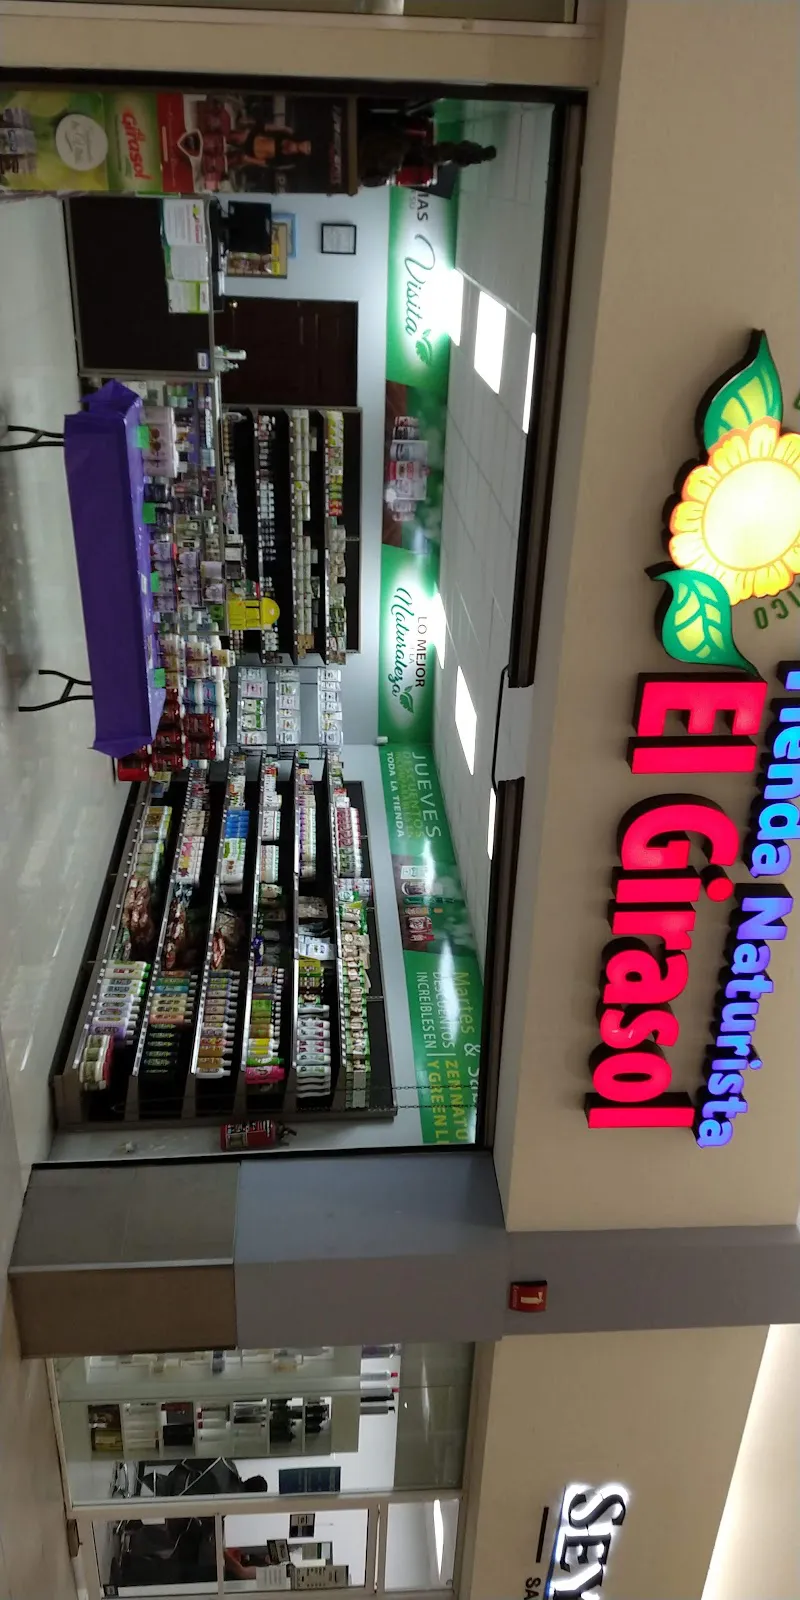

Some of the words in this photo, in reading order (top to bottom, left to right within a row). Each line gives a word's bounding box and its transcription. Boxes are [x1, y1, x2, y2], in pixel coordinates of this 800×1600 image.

[404, 234, 436, 337] Visita
[388, 587, 415, 698] Naturaleza
[417, 616, 427, 635] LO
[415, 640, 427, 688] MEJOR
[631, 681, 768, 774] El
[387, 752, 396, 776] TODA
[390, 781, 398, 791] LA
[750, 671, 800, 877] enda
[392, 795, 405, 838] TIENDA
[412, 752, 441, 838] JUEVES
[588, 803, 739, 1129] Girasol
[417, 972, 434, 1031] INCREÍBLES
[433, 972, 456, 1048] DESCUENTOS
[453, 972, 475, 1034] Martes
[464, 1043, 481, 1056] &
[697, 898, 793, 1148] Naturista
[424, 1033, 436, 1048] EN
[427, 1061, 439, 1069] Y
[429, 1072, 446, 1126] GREEN
[445, 1060, 461, 1090] ZEN
[520, 1291, 544, 1305] 1
